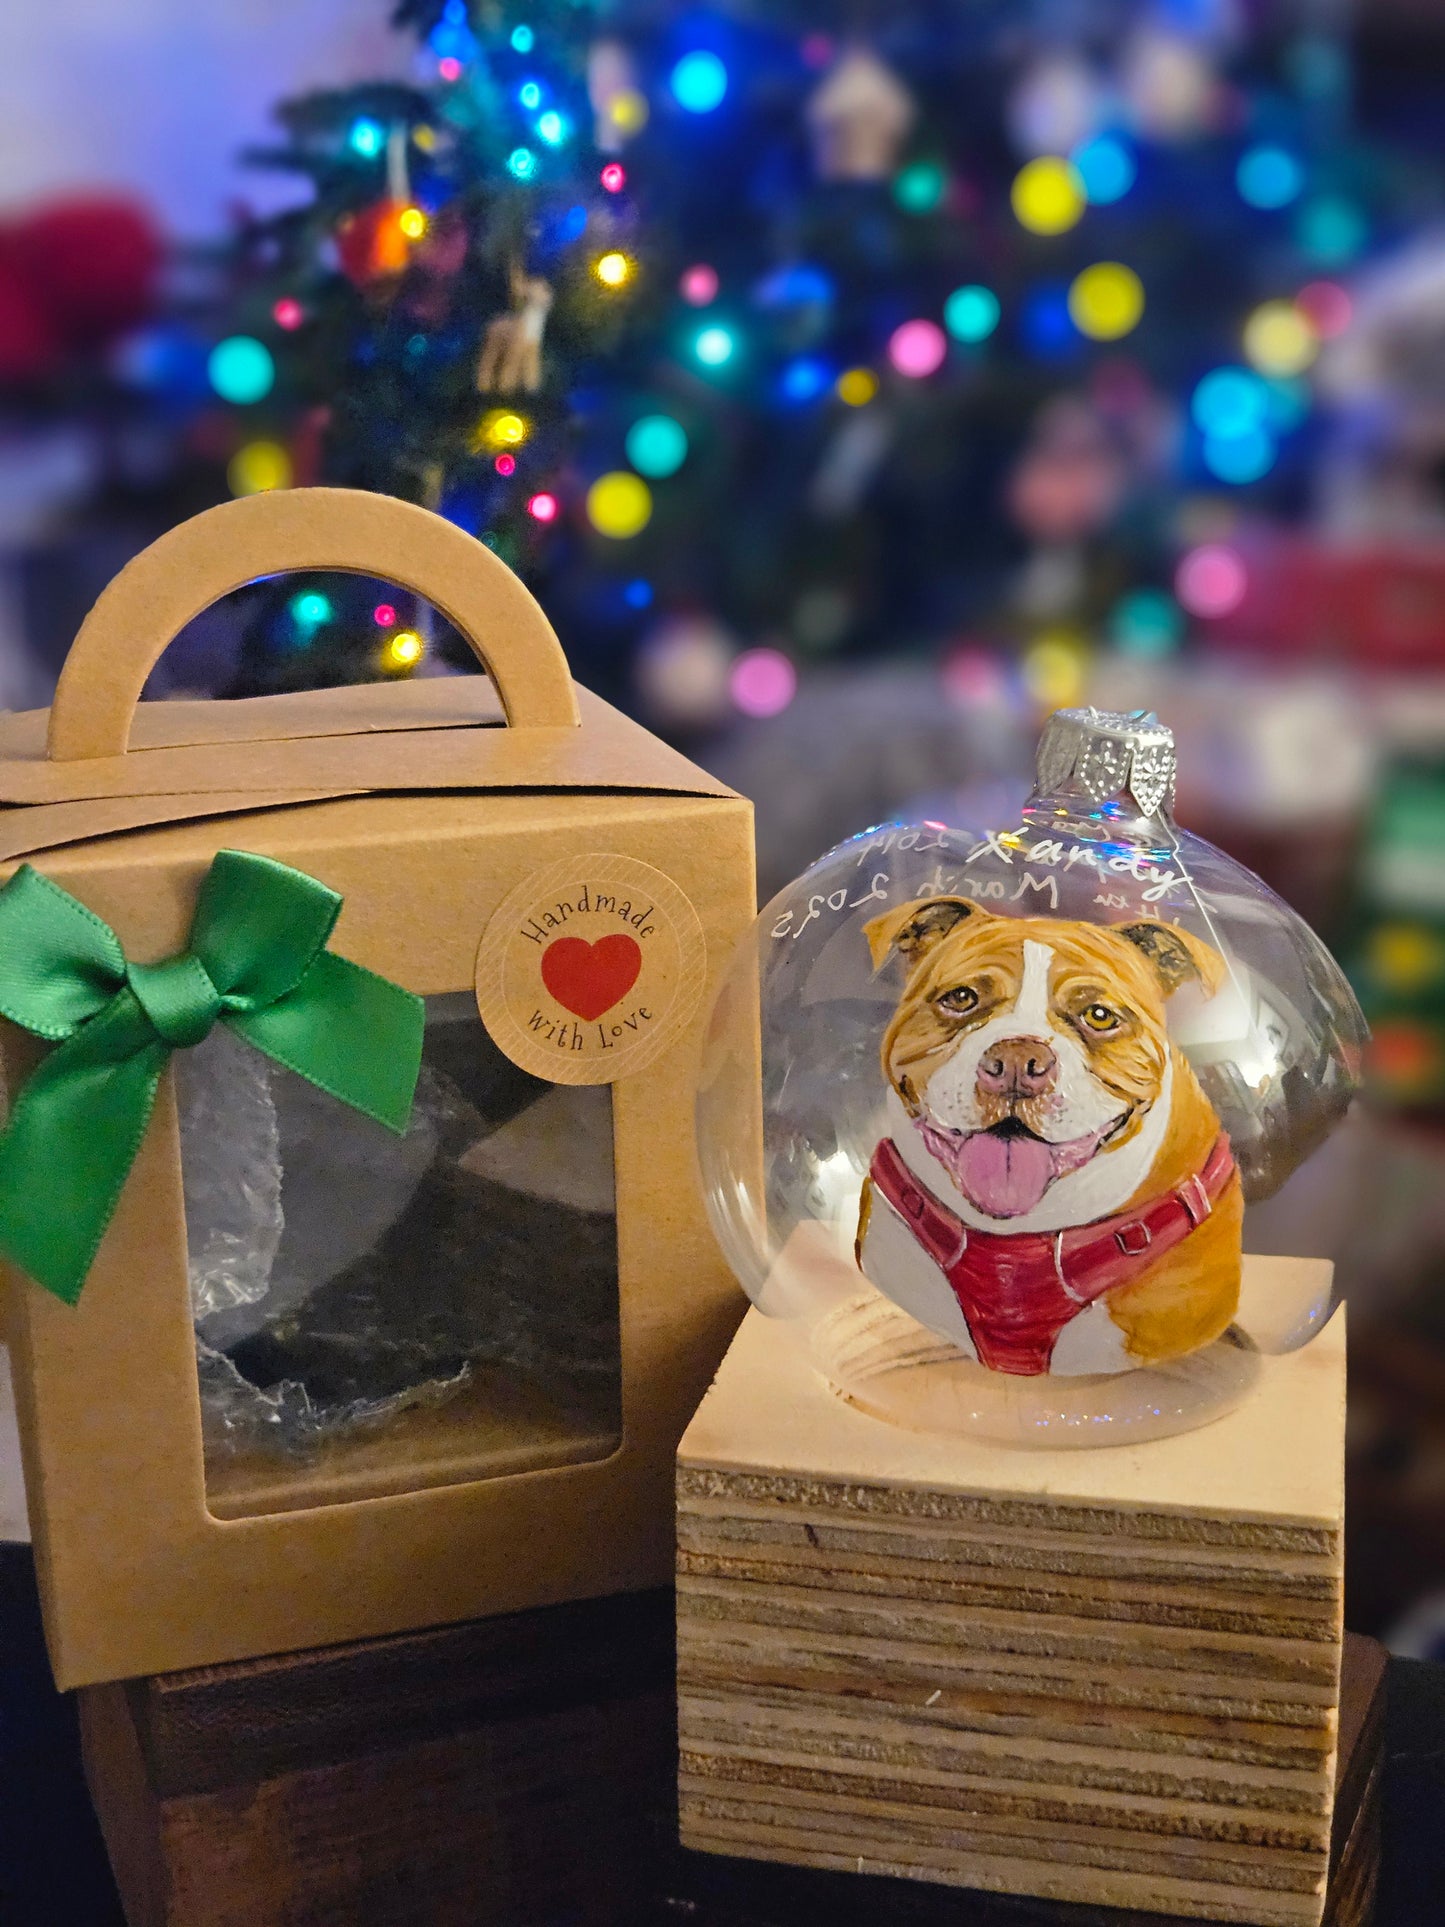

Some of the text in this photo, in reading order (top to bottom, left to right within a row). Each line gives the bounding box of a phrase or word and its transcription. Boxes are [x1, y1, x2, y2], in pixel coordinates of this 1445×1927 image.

[966, 827, 1193, 901] Xandy
[521, 885, 654, 944] Handmade
[528, 1007, 653, 1051] with Love
